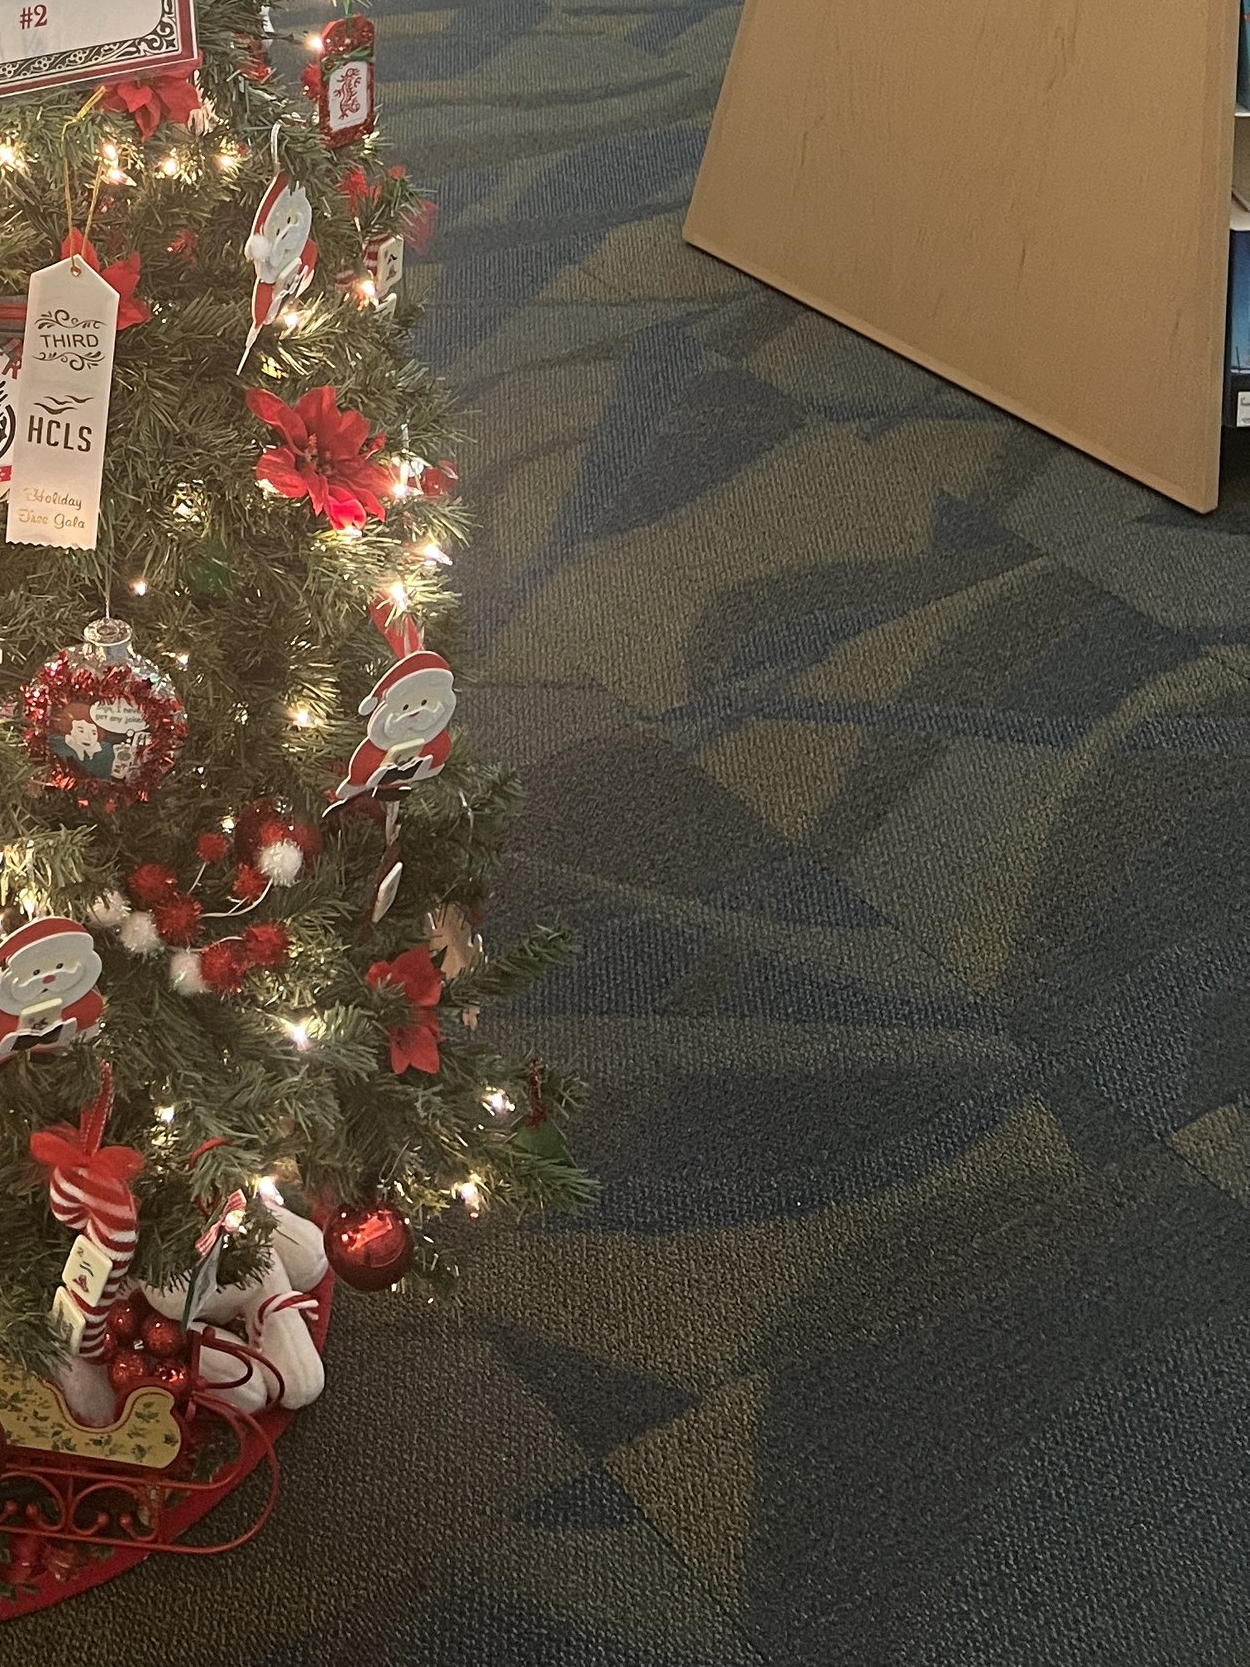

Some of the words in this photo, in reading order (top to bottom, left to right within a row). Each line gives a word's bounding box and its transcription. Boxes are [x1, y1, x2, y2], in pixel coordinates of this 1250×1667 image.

[19, 4, 48, 30] #2
[40, 334, 99, 348] THIRD
[27, 414, 92, 452] HCLS
[24, 488, 82, 511] Holiday
[54, 514, 85, 529] Gala
